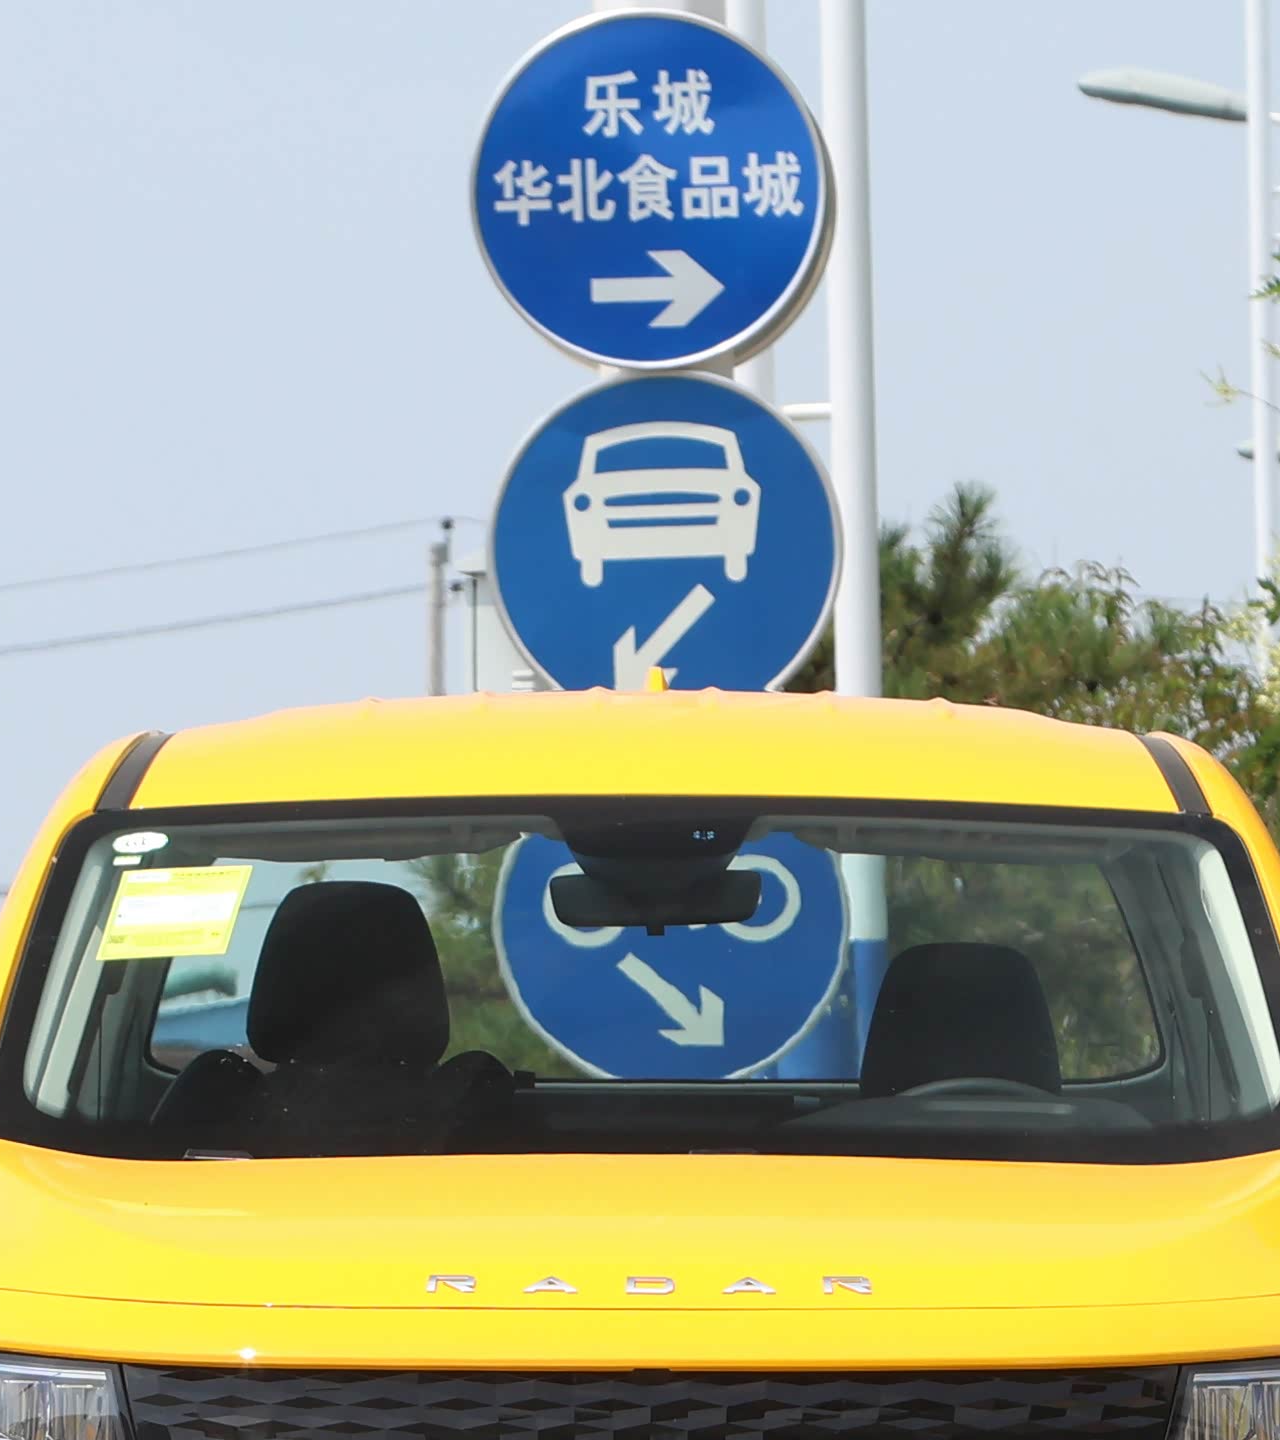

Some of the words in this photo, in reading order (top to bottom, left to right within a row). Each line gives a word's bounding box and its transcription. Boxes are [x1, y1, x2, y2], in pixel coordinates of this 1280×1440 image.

[582, 68, 716, 138] 乐城
[492, 150, 805, 226] 华北食品城
[425, 1274, 873, 1296] RADAR
